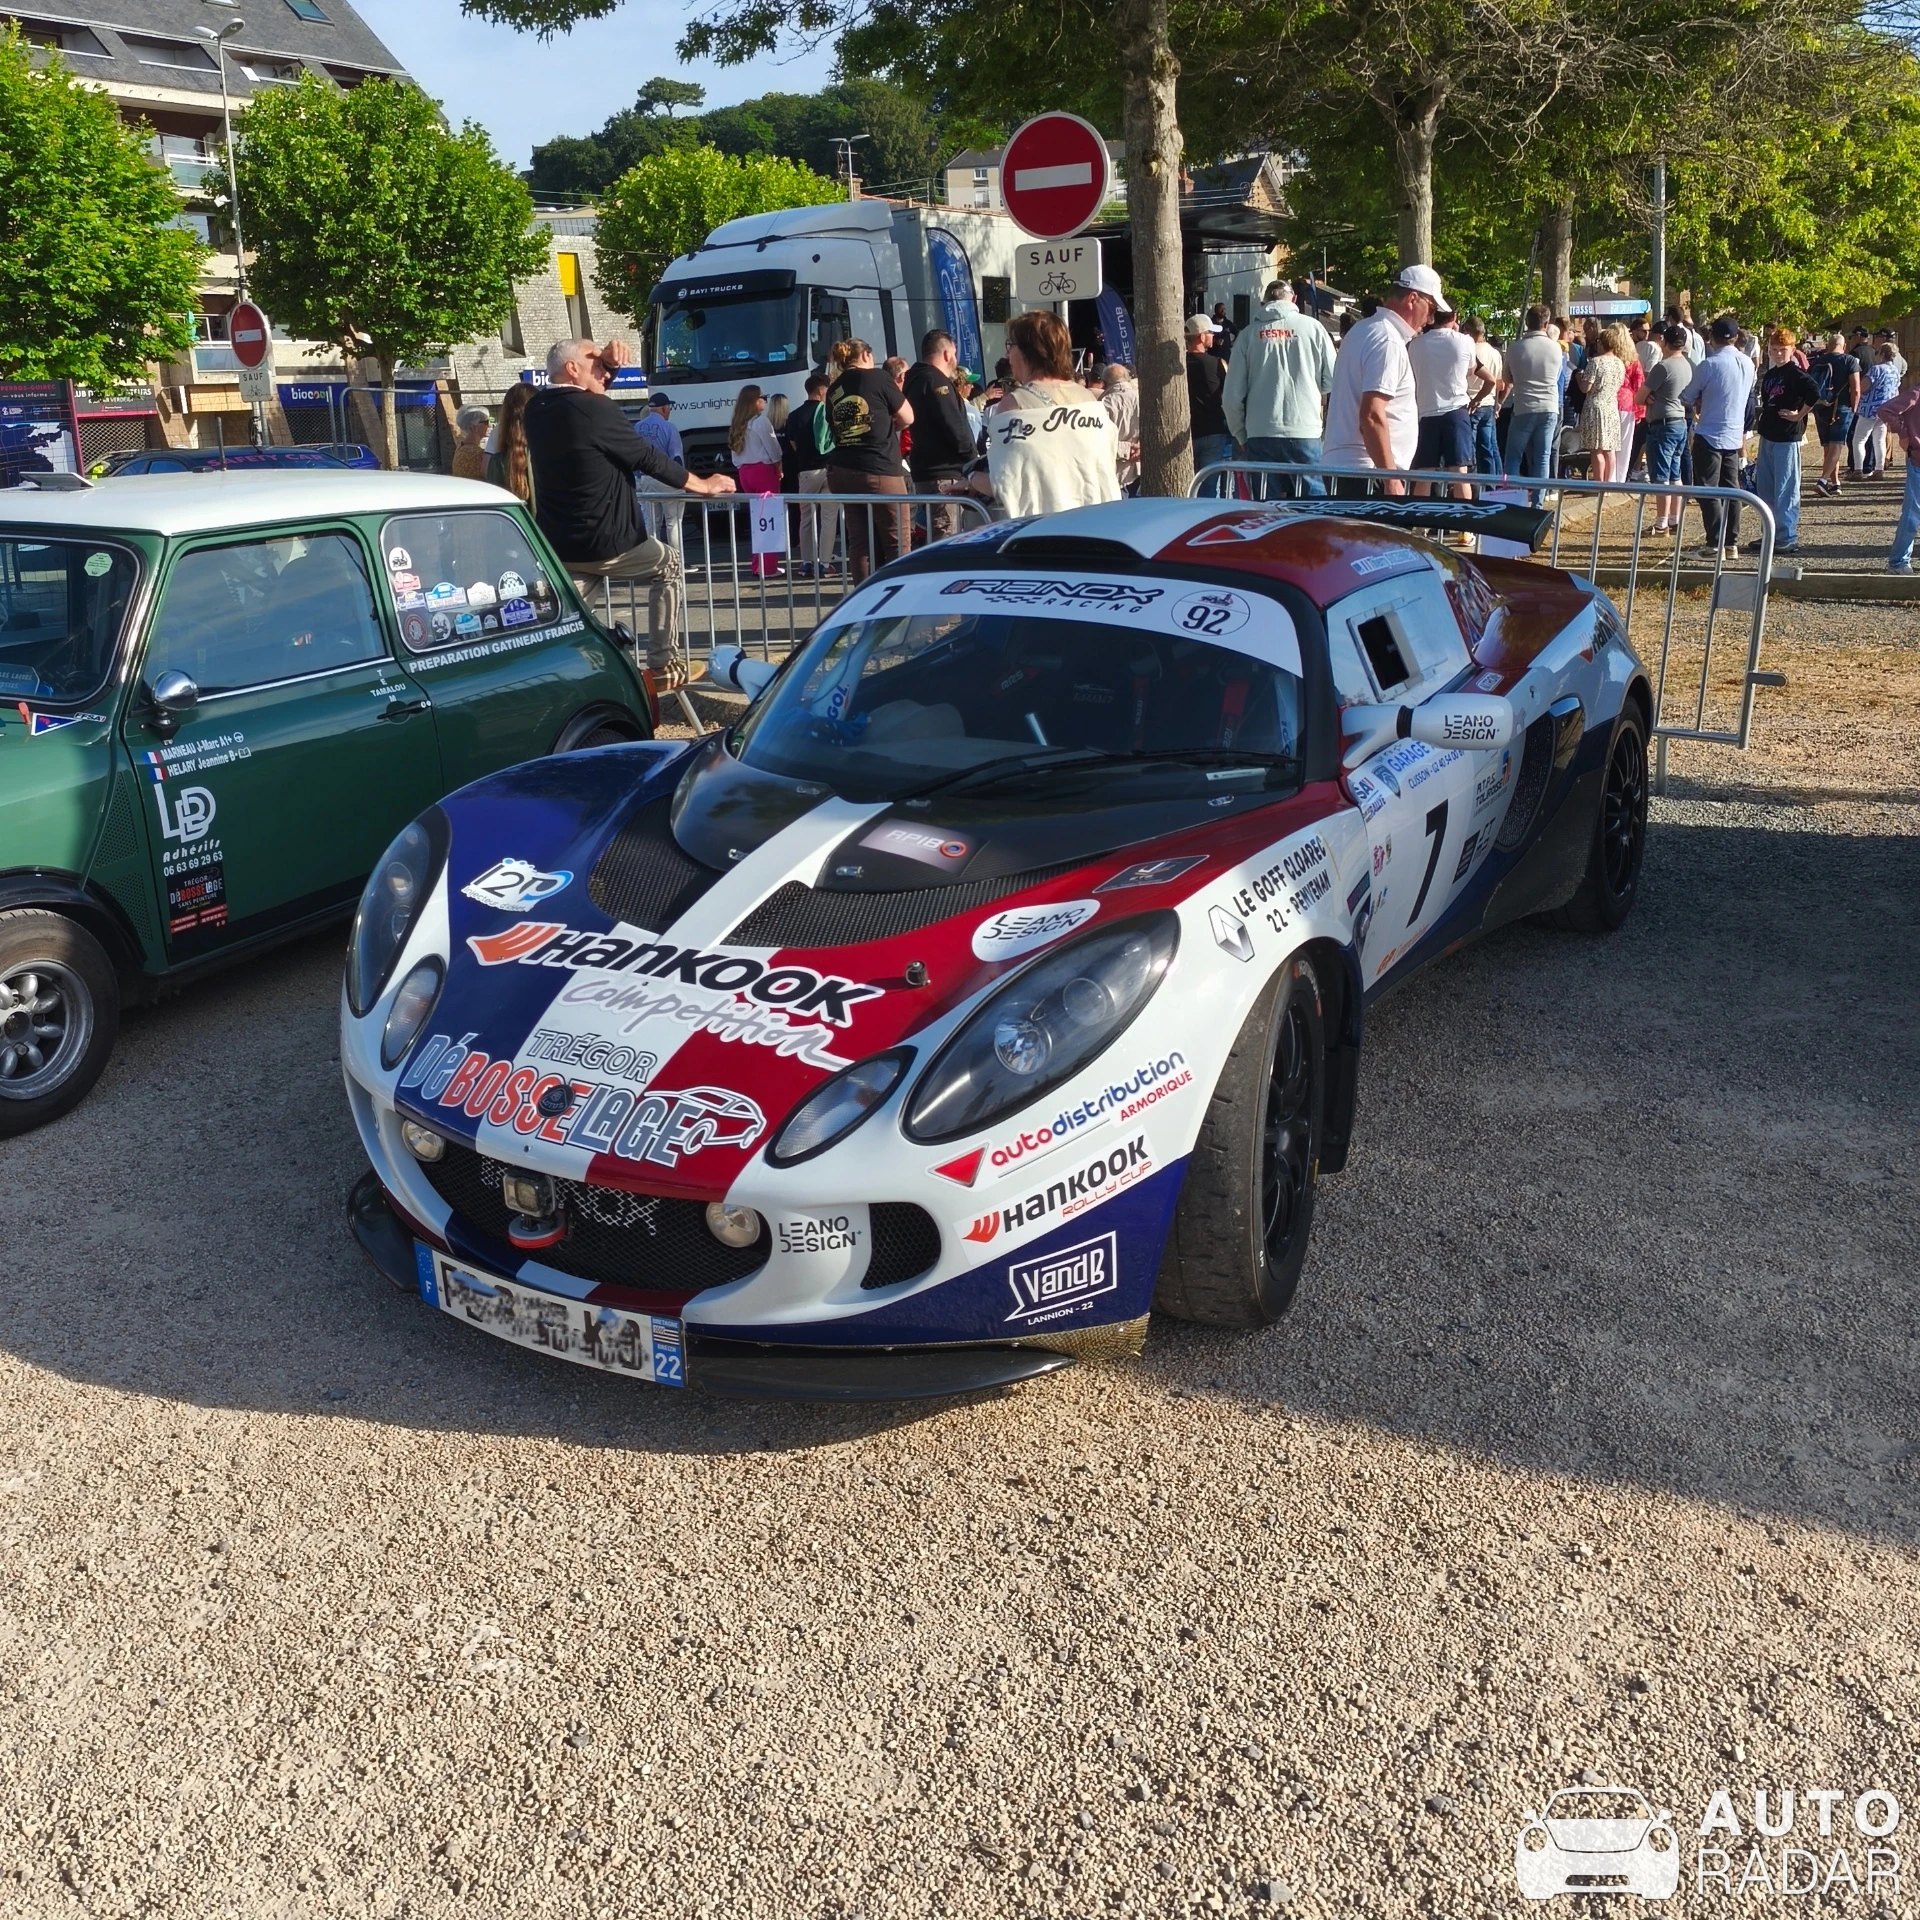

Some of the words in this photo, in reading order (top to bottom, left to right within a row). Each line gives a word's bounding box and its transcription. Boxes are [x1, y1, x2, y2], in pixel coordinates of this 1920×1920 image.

[1030, 247, 1083, 266] SAUF
[710, 284, 743, 293] TRUCKS
[1569, 304, 1592, 315] rrasse
[243, 372, 263, 382] SAUF
[1042, 407, 1104, 432] Mans
[206, 454, 278, 467] SAFETY
[285, 453, 324, 462] CAR
[759, 517, 775, 532] 91
[1043, 597, 1144, 614] RACING
[1182, 604, 1231, 635] 92
[408, 646, 489, 673] PREPARATION
[492, 631, 543, 654] GATINEAU
[545, 620, 585, 640] FRANCIS
[370, 683, 406, 697] TAMALOU
[827, 684, 850, 721] GOL
[1444, 714, 1494, 728] LEANO
[1281, 720, 1292, 756] IGO
[1442, 728, 1497, 740] DESIGN
[160, 742, 197, 761] MARNEAU
[196, 738, 220, 752] J-Marc
[1387, 741, 1430, 773] GARAGE
[166, 759, 197, 777] HELARY
[197, 752, 230, 770] Jeannine
[163, 865, 175, 877] 06
[176, 862, 187, 873] 63
[188, 858, 199, 869] 69
[200, 854, 211, 866] 29
[212, 850, 224, 862] 63
[1233, 888, 1257, 918] LE
[1252, 864, 1287, 903] GOFF
[1283, 835, 1326, 880] CLOAREC
[1266, 906, 1289, 933] 22
[1290, 868, 1332, 916] PENVENAN
[982, 916, 1084, 940] DESIGN
[994, 907, 1086, 929] LEANO
[529, 1028, 659, 1084] TRÉGOR
[1120, 1070, 1193, 1122] ARMORIQUE
[990, 1051, 1185, 1167] autodistribution
[1119, 1160, 1153, 1186] CUP
[779, 1216, 850, 1238] LEANO
[780, 1234, 857, 1254] DESIGN
[425, 1280, 432, 1294] F
[1027, 1306, 1073, 1326] LANNION
[1081, 1301, 1094, 1310] 22
[655, 1352, 682, 1380] 22
